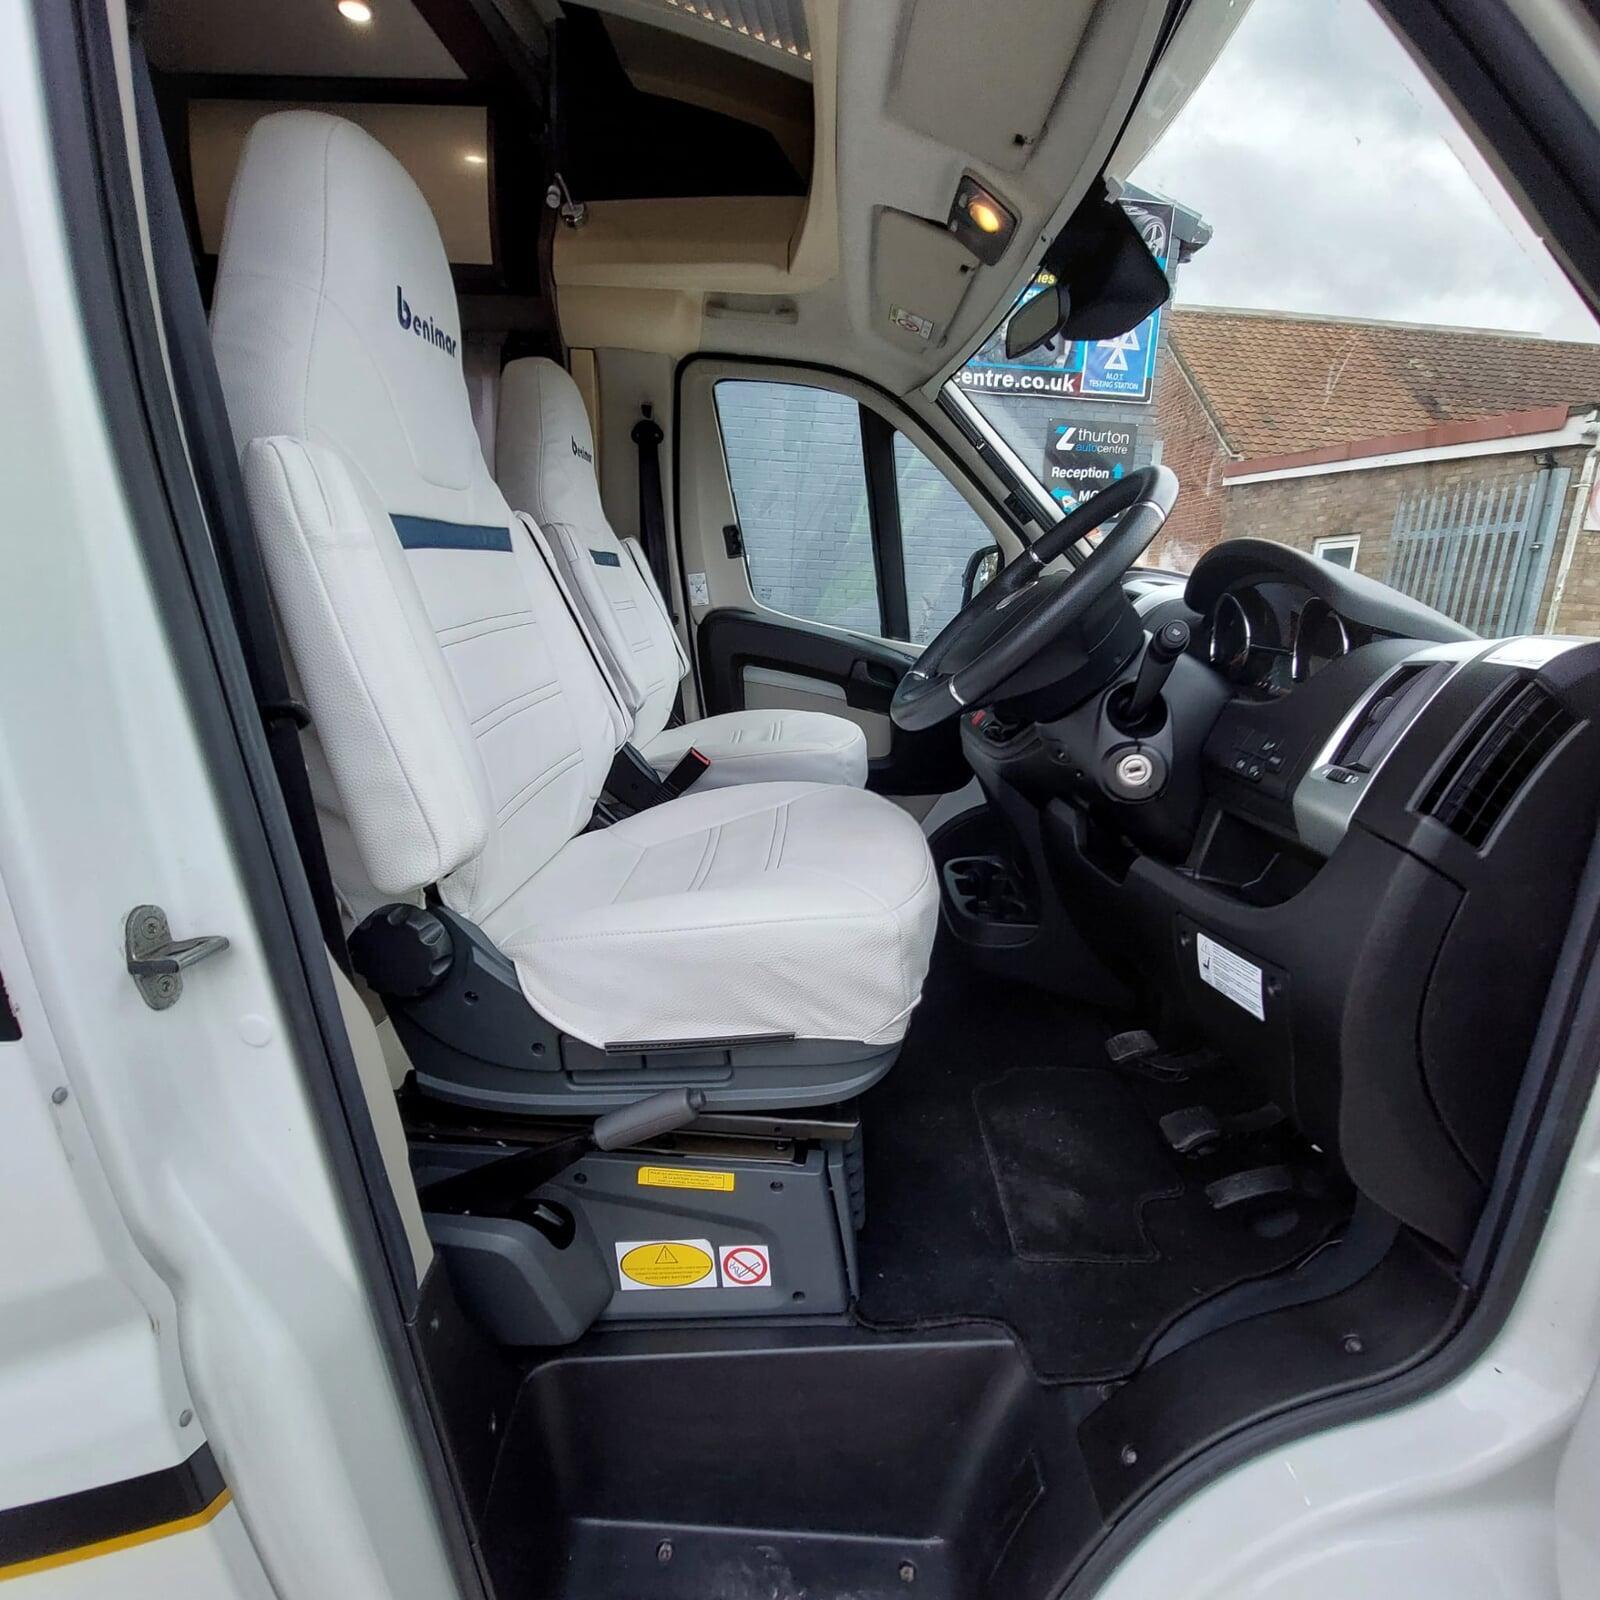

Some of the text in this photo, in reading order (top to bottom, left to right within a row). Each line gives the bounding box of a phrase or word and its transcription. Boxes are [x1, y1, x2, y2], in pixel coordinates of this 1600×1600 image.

[396, 285, 457, 358] benimar
[1078, 428, 1130, 444] thurton
[1075, 443, 1128, 455] autocentre
[1051, 466, 1110, 480] Reception
